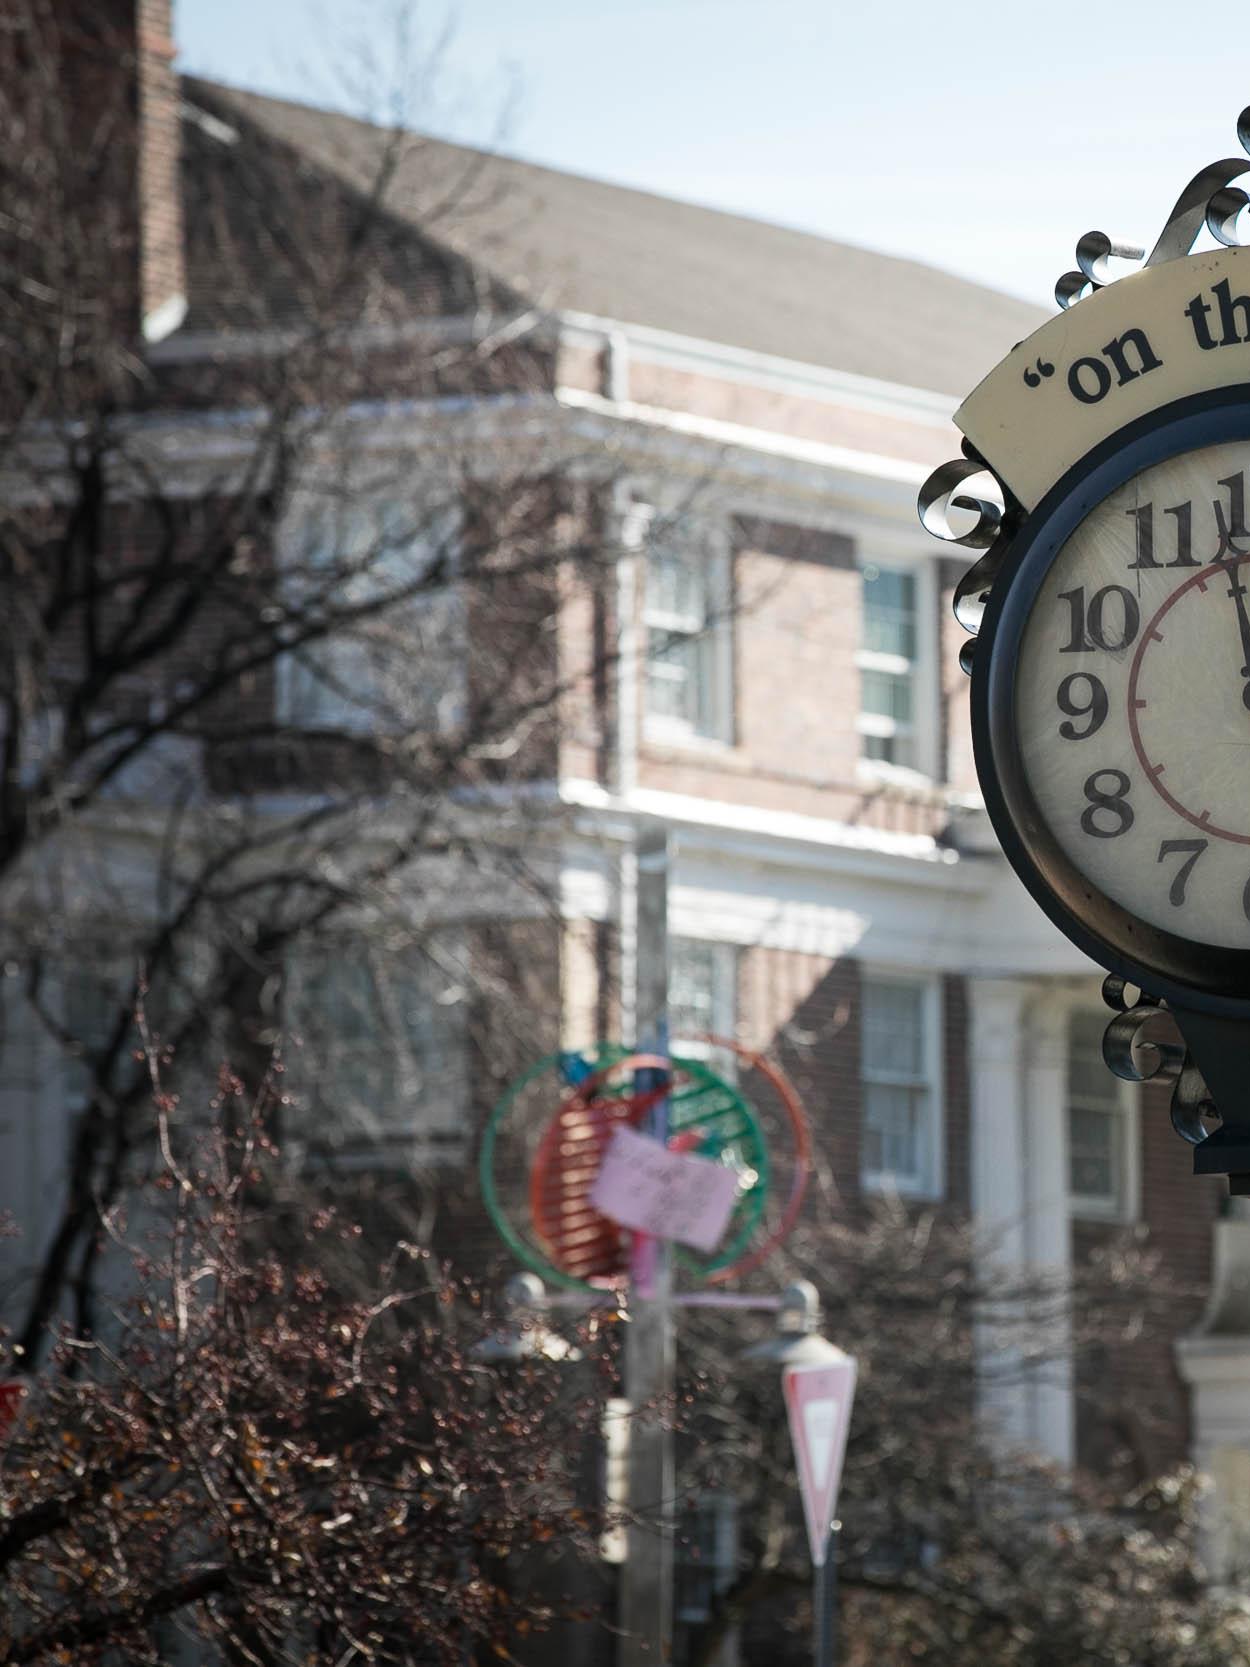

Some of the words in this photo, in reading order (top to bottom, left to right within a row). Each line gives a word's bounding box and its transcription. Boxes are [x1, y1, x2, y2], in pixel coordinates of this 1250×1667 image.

[1022, 326, 1163, 404] “on
[1126, 500, 1202, 569] 11
[1056, 584, 1141, 653] 10
[1056, 672, 1109, 741] 9
[1079, 768, 1135, 839] 8
[1156, 838, 1209, 907] 7
